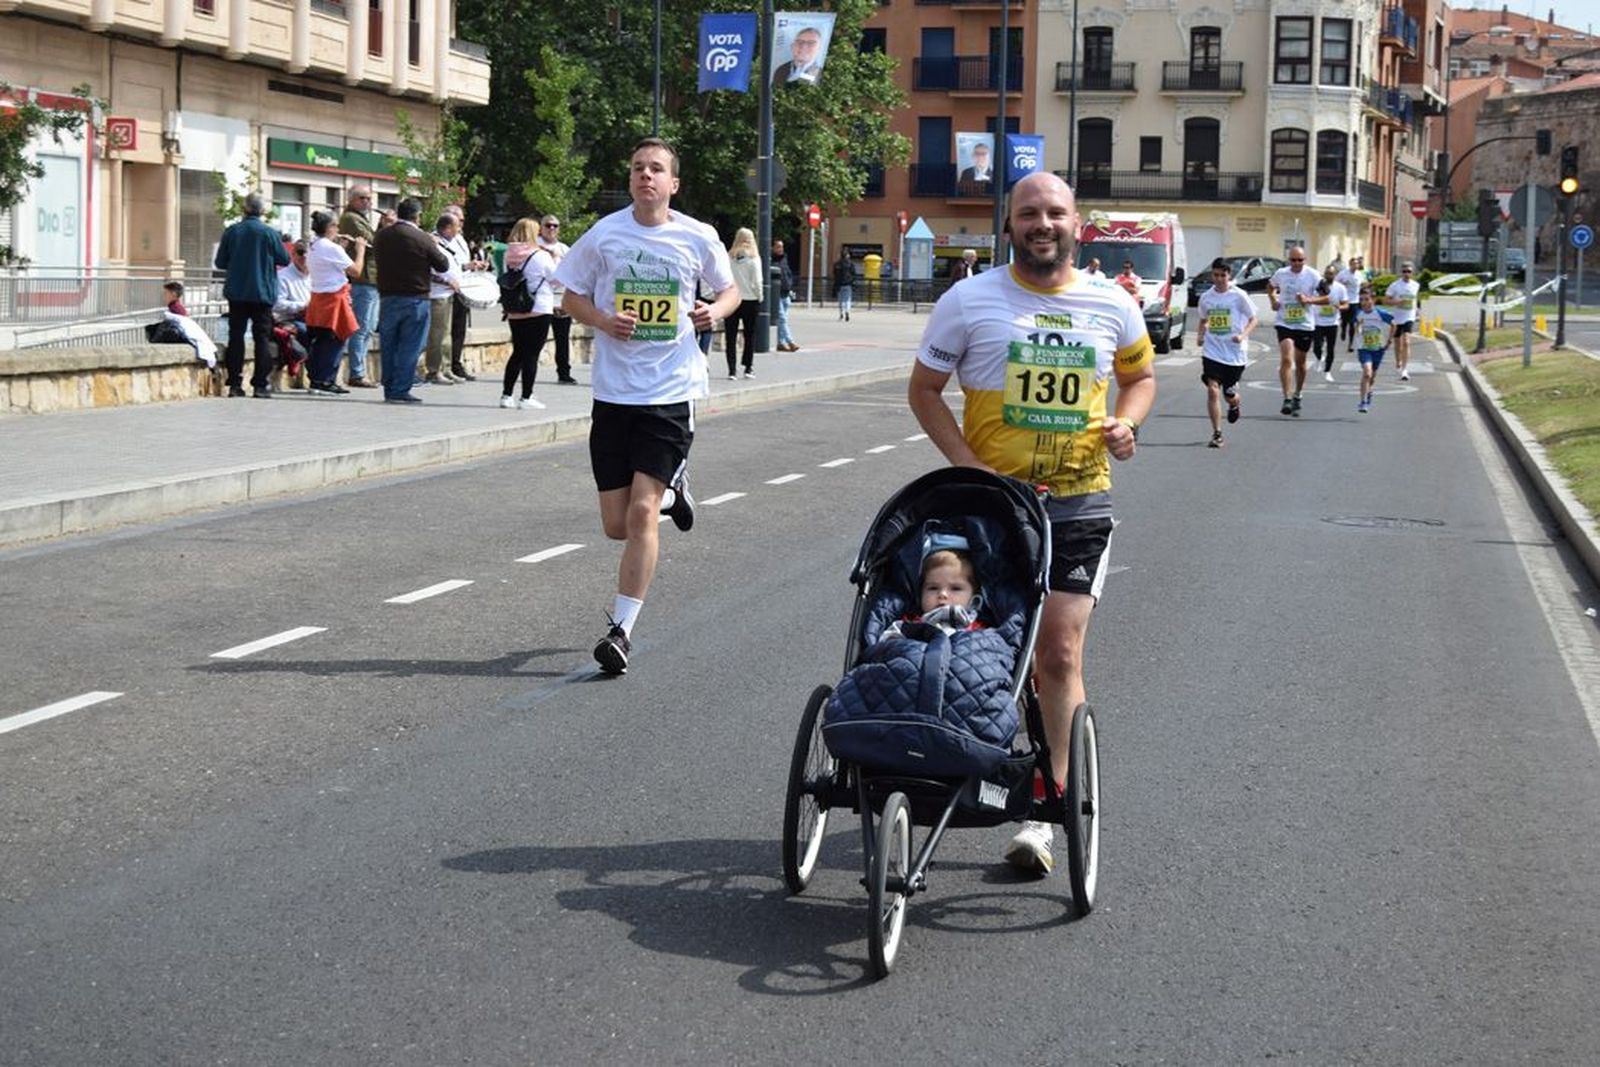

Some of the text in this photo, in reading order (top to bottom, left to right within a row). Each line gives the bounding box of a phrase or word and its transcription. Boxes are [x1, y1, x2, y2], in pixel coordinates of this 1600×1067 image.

[708, 34, 742, 45] VOTA
[1013, 145, 1037, 154] VOTA
[1208, 316, 1228, 327] 501
[1016, 369, 1080, 405] 130
[1028, 413, 1084, 425] CAJA RURAL
